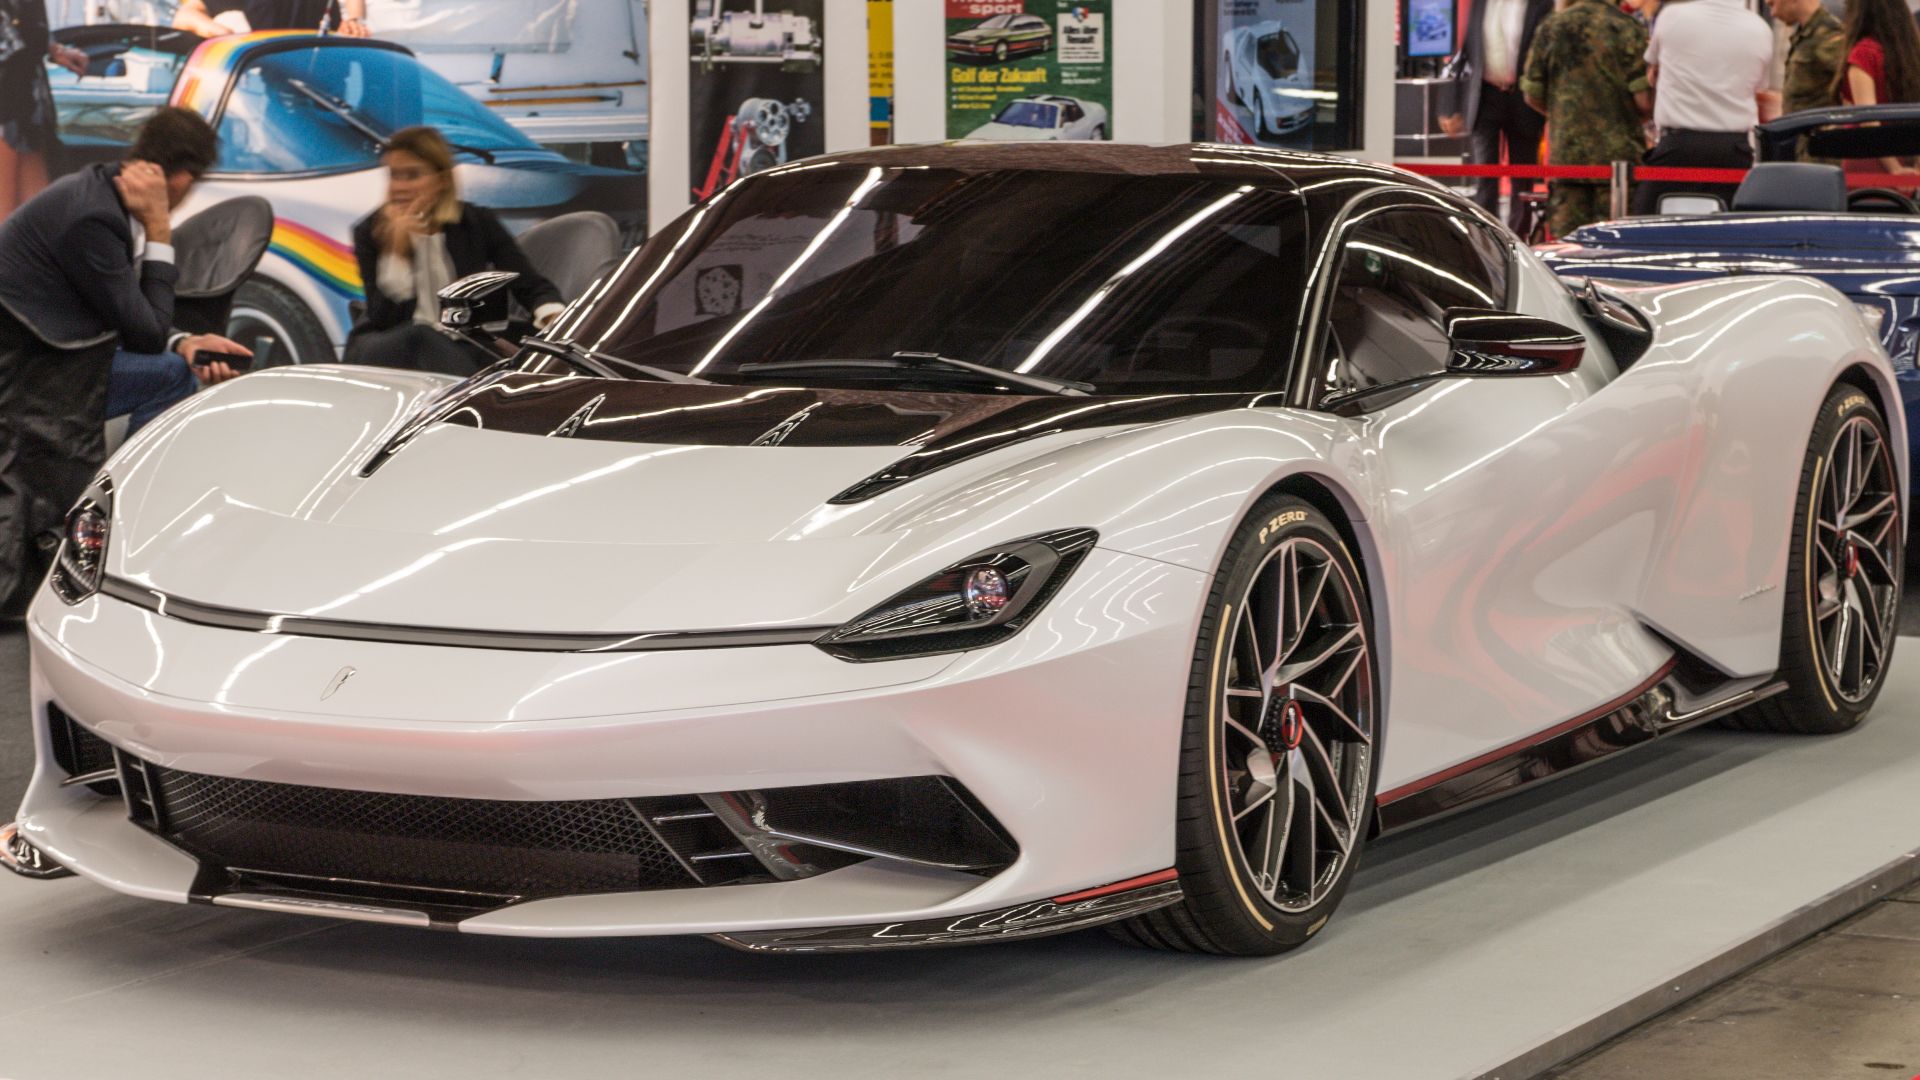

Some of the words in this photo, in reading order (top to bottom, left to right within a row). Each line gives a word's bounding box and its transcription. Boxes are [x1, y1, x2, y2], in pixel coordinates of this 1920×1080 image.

[969, 4, 1024, 15] sport
[952, 67, 977, 83] Golf
[978, 67, 998, 83] der
[1000, 67, 1046, 83] Zukunft
[1259, 527, 1268, 544] P
[1268, 511, 1305, 533] ZERO
